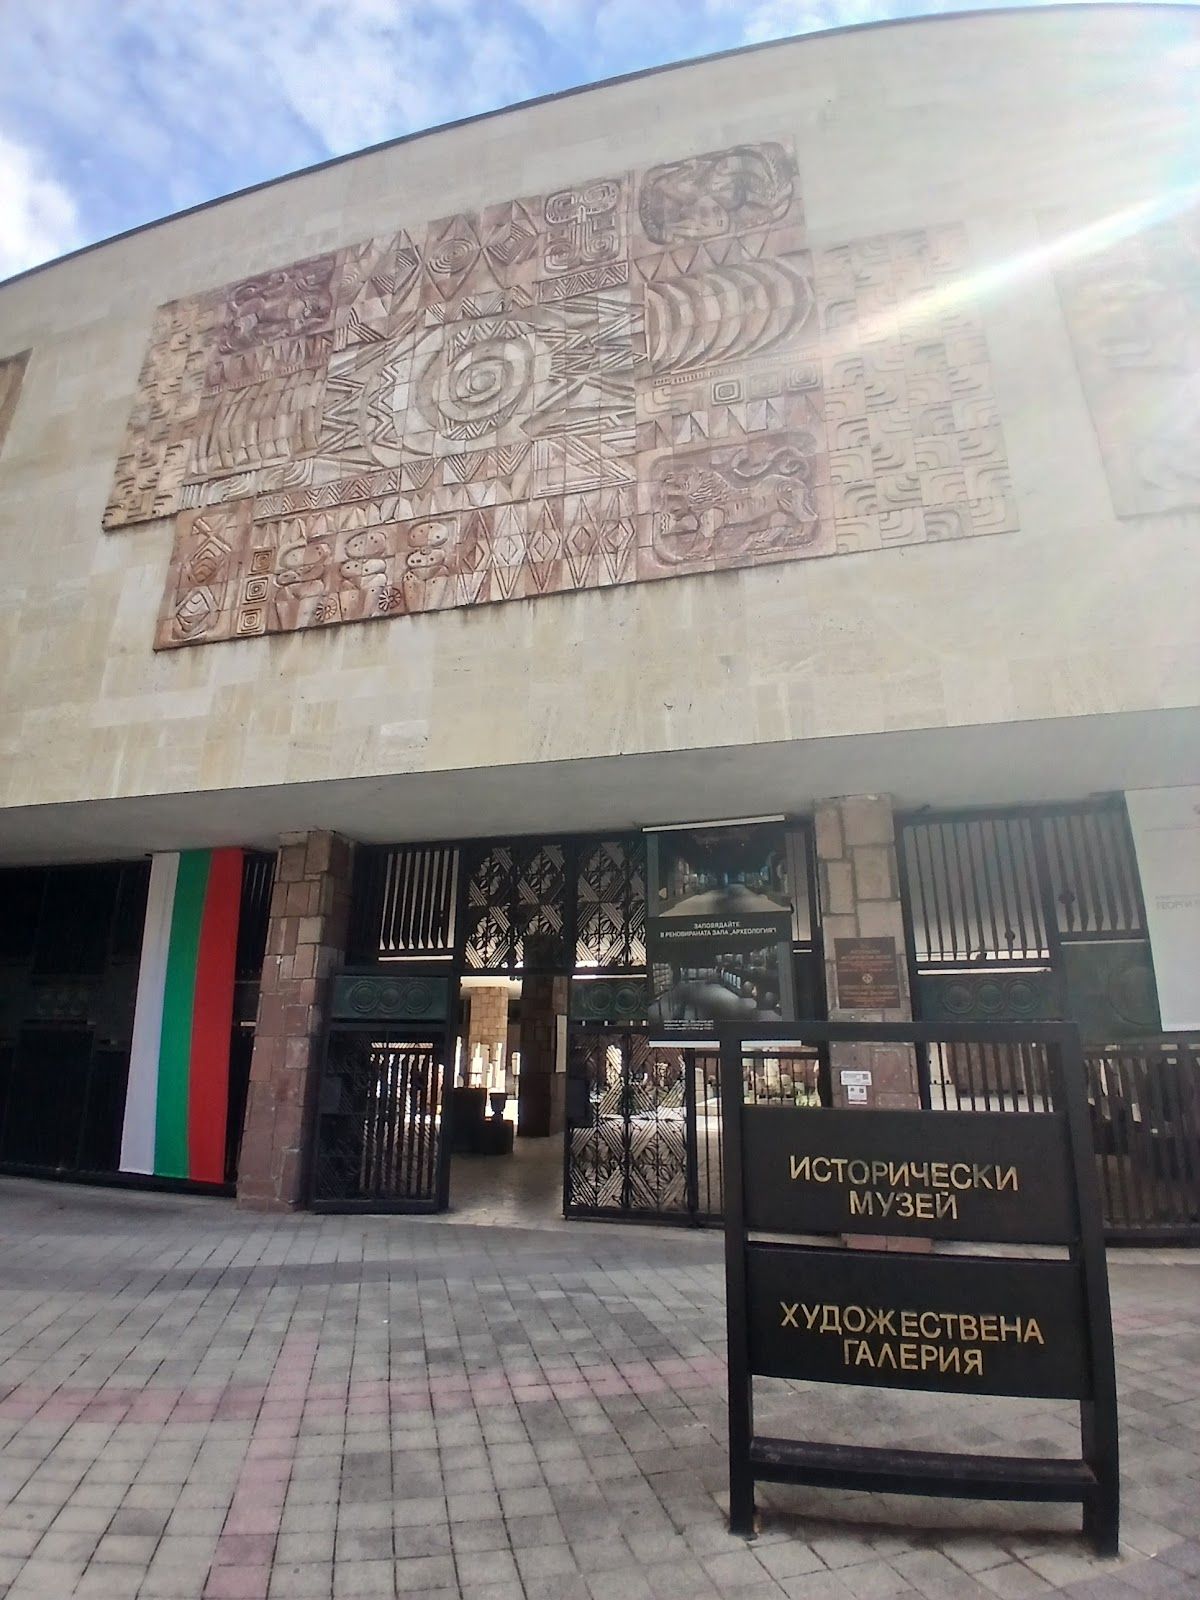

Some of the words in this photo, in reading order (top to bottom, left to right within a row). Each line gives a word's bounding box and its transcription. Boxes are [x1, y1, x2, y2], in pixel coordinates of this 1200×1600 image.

[694, 921, 740, 929] ЗАПОВЯДАЙТЕ
[789, 1155, 1018, 1191] ИСТОРИЧЕСКИ
[849, 1190, 958, 1219] МУЗЕЙ
[780, 1302, 1045, 1344] ХУДОЖЕСТВЕНА
[843, 1339, 984, 1376] ГАЛЕРИЯ
